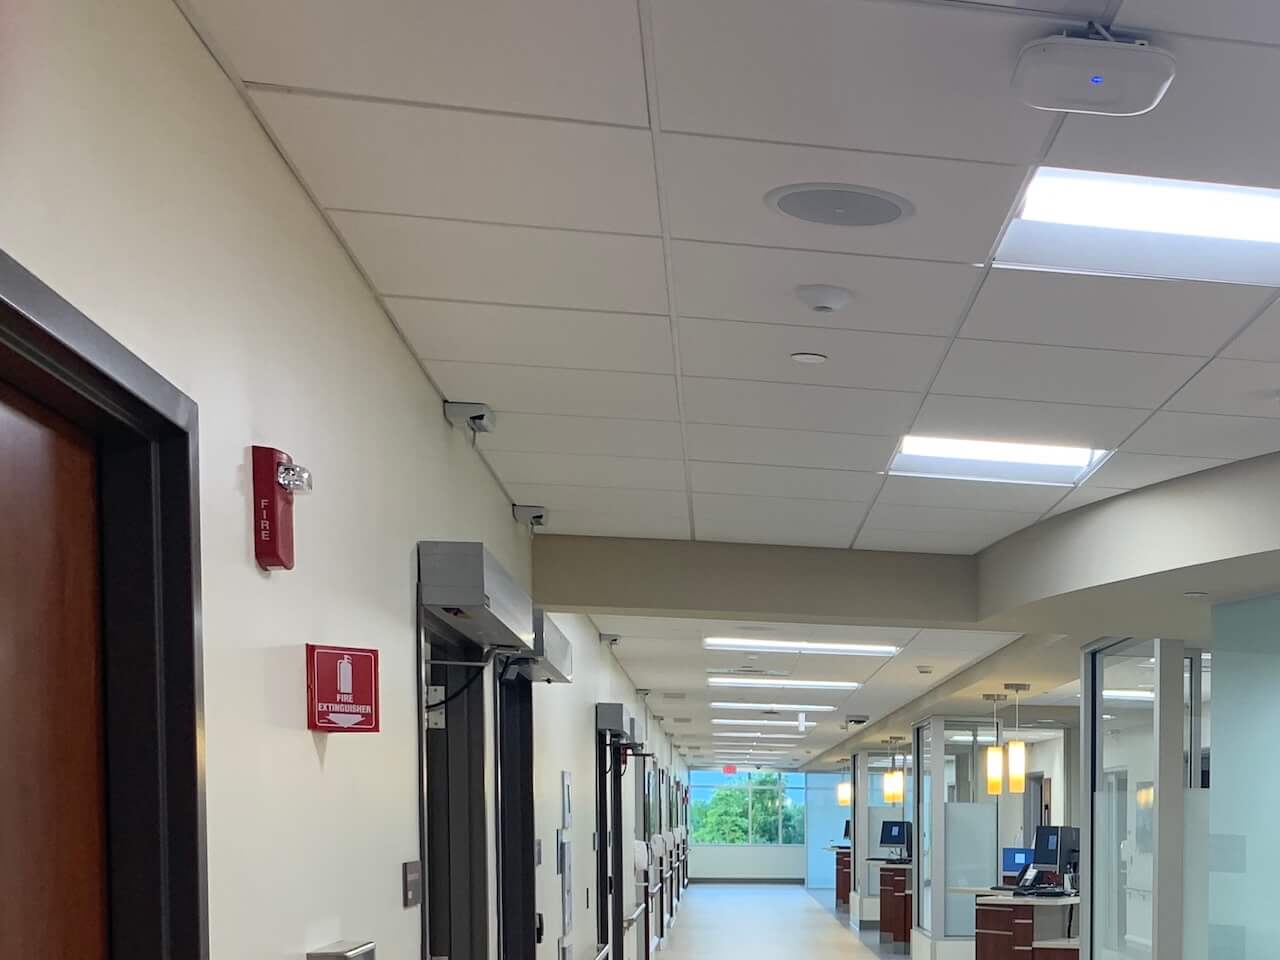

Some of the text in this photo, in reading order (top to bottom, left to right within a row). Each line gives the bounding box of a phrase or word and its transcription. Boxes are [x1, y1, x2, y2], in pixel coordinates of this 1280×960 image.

[261, 499, 270, 540] FIRE
[336, 693, 354, 703] FIRE
[318, 702, 372, 713] EXTINGUISHER
